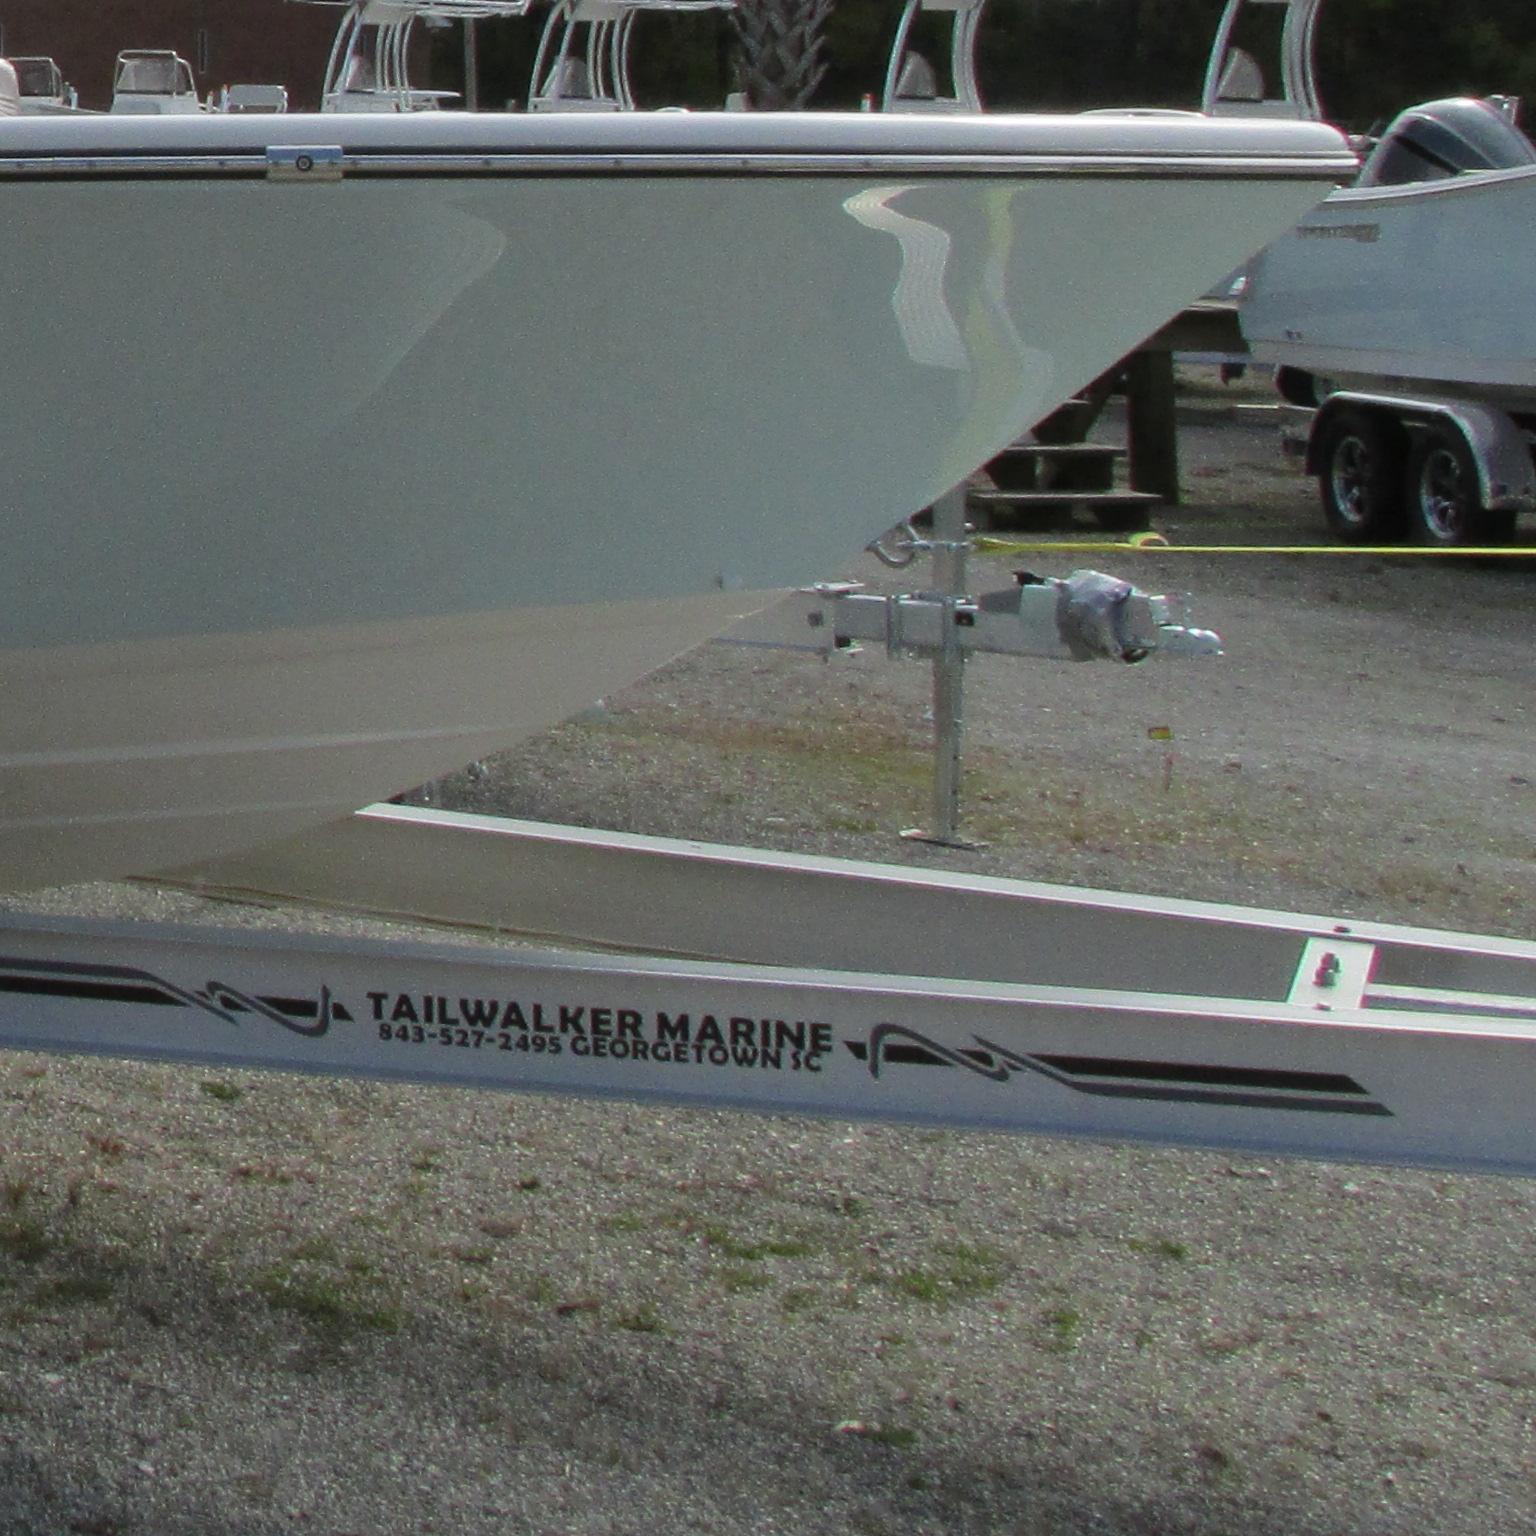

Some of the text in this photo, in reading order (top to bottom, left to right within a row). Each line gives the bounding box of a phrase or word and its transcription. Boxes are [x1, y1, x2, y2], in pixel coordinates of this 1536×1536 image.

[366, 990, 833, 1053] TAILWALKER MARINE
[378, 1022, 823, 1074] 843-527-2495 GEORGETOWN SC
